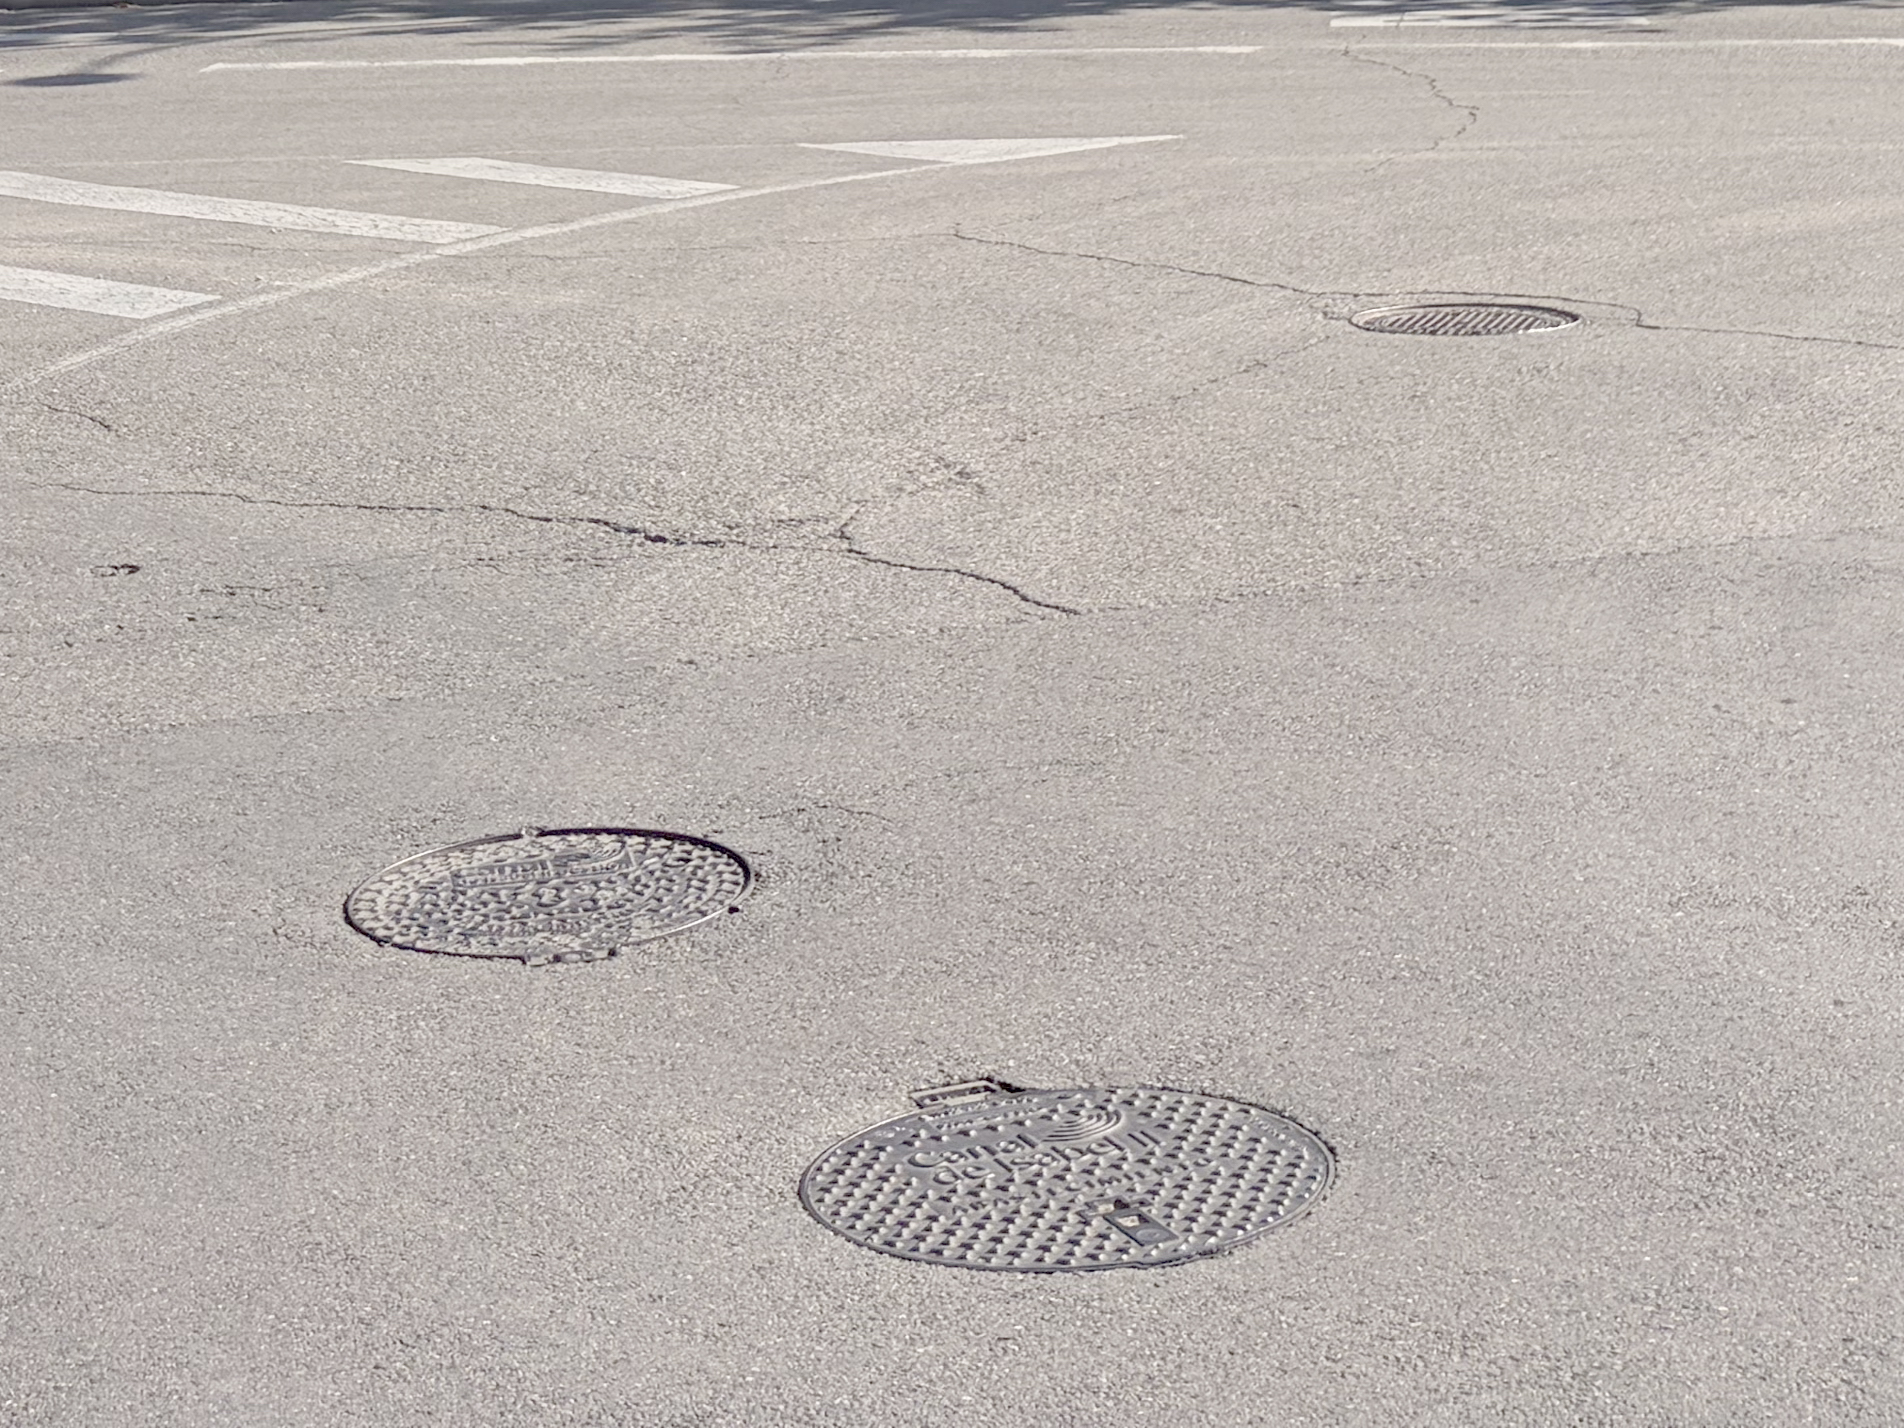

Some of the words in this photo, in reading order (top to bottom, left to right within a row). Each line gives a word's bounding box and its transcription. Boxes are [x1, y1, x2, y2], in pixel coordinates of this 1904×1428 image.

[907, 1133, 1037, 1169] Canal
[933, 1161, 991, 1185] de
[994, 1136, 1126, 1173] Isabel
